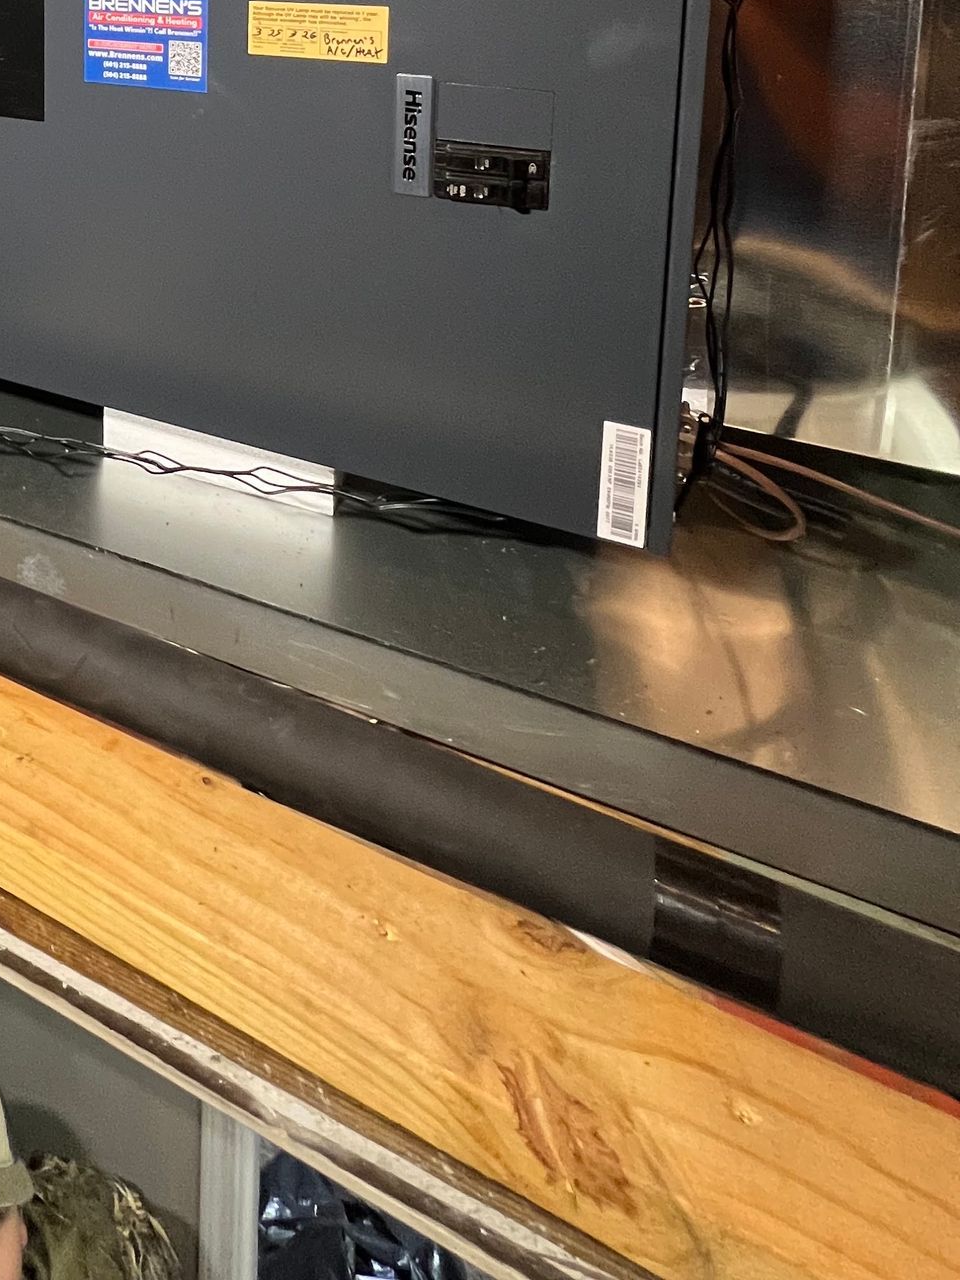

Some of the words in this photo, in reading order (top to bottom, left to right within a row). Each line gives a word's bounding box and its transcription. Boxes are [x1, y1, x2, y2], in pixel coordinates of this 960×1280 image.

[92, 12, 104, 20] Air
[106, 13, 155, 25] Conditioning
[157, 16, 164, 24] &
[165, 16, 198, 28] Heating
[302, 31, 317, 39] 26
[88, 50, 163, 62] www.Brennens.com
[403, 89, 422, 182] Hisense
